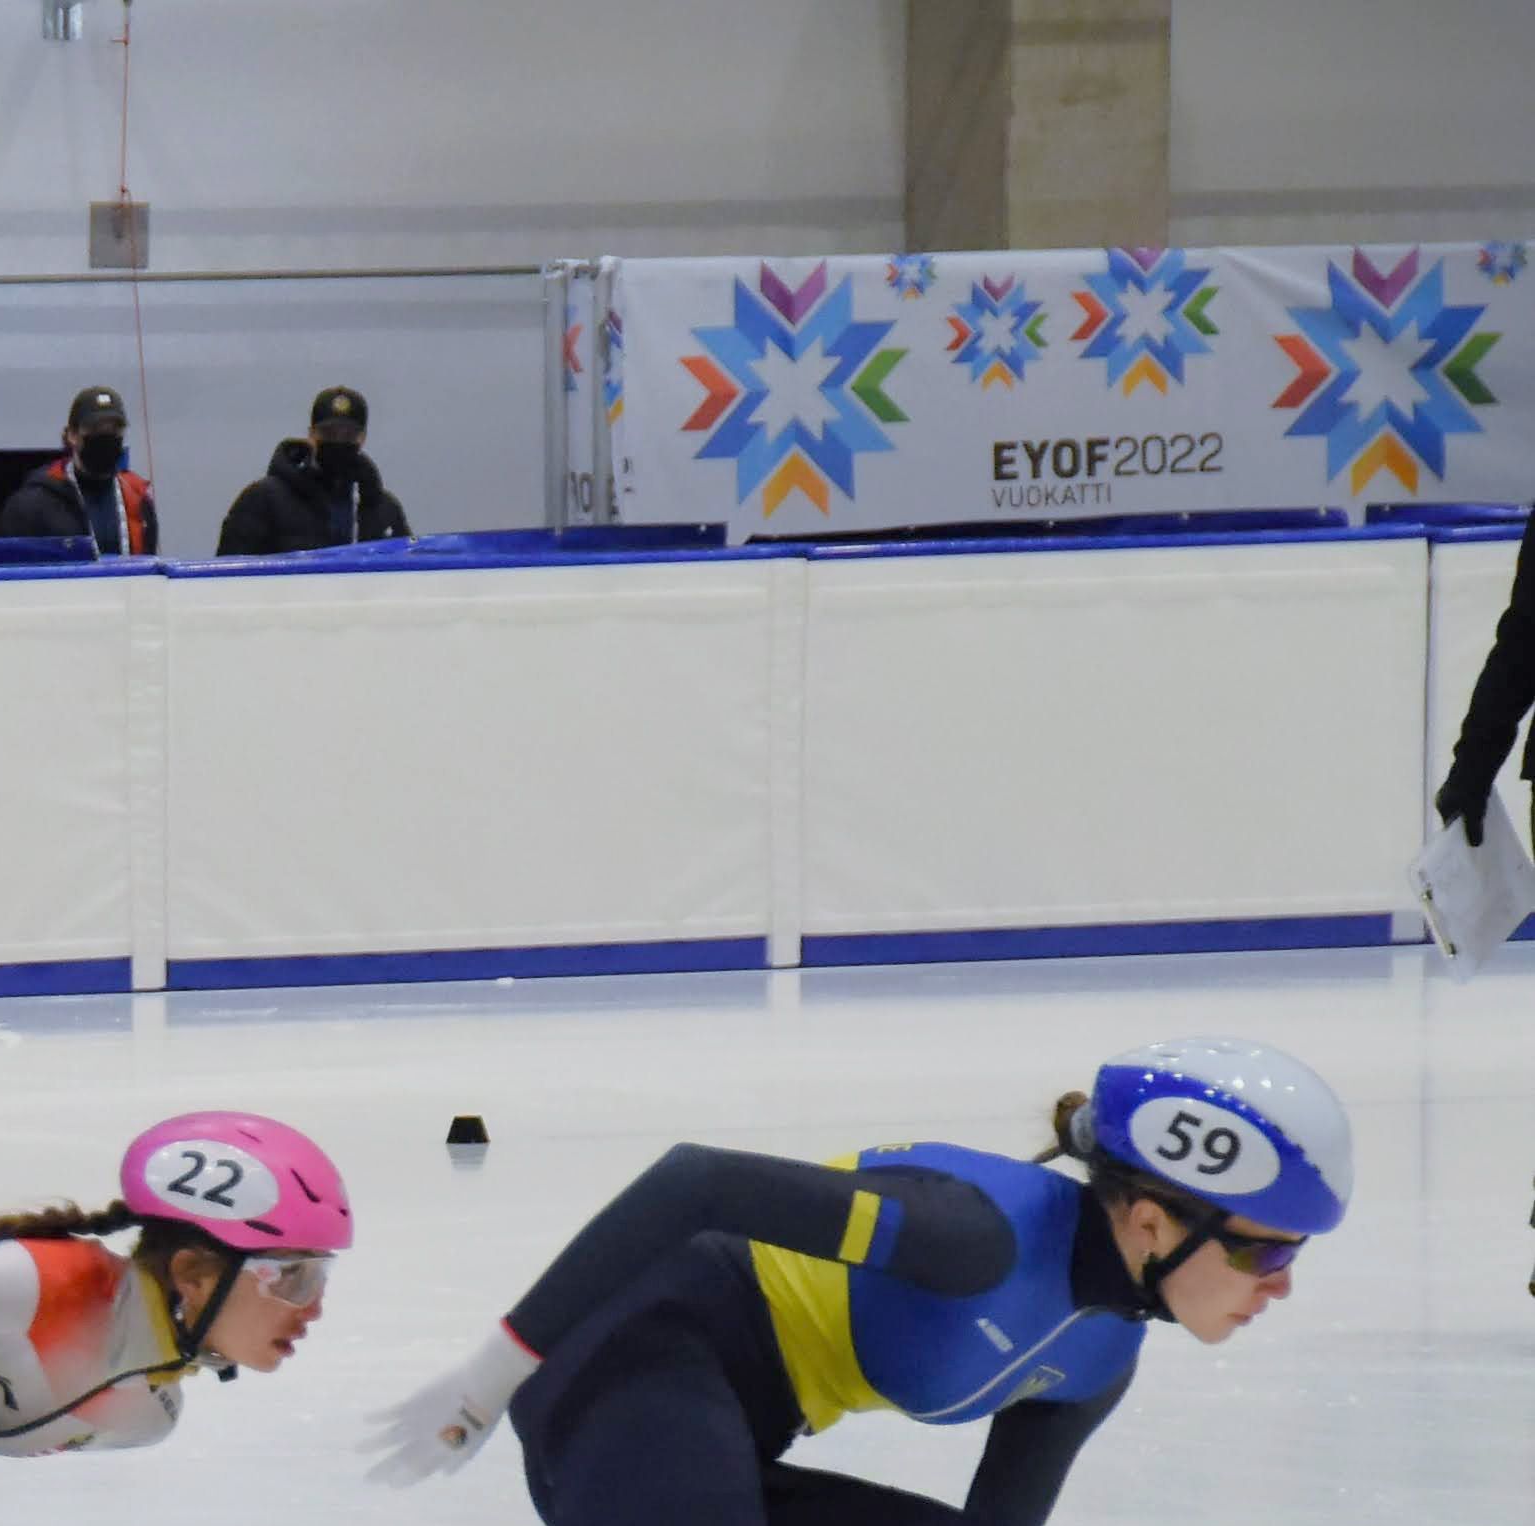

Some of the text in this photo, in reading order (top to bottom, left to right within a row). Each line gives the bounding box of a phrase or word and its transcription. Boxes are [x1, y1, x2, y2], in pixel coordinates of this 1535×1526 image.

[991, 483, 1111, 508] VUOKATTI
[1156, 1111, 1241, 1176] 59
[166, 1149, 245, 1208] 22
